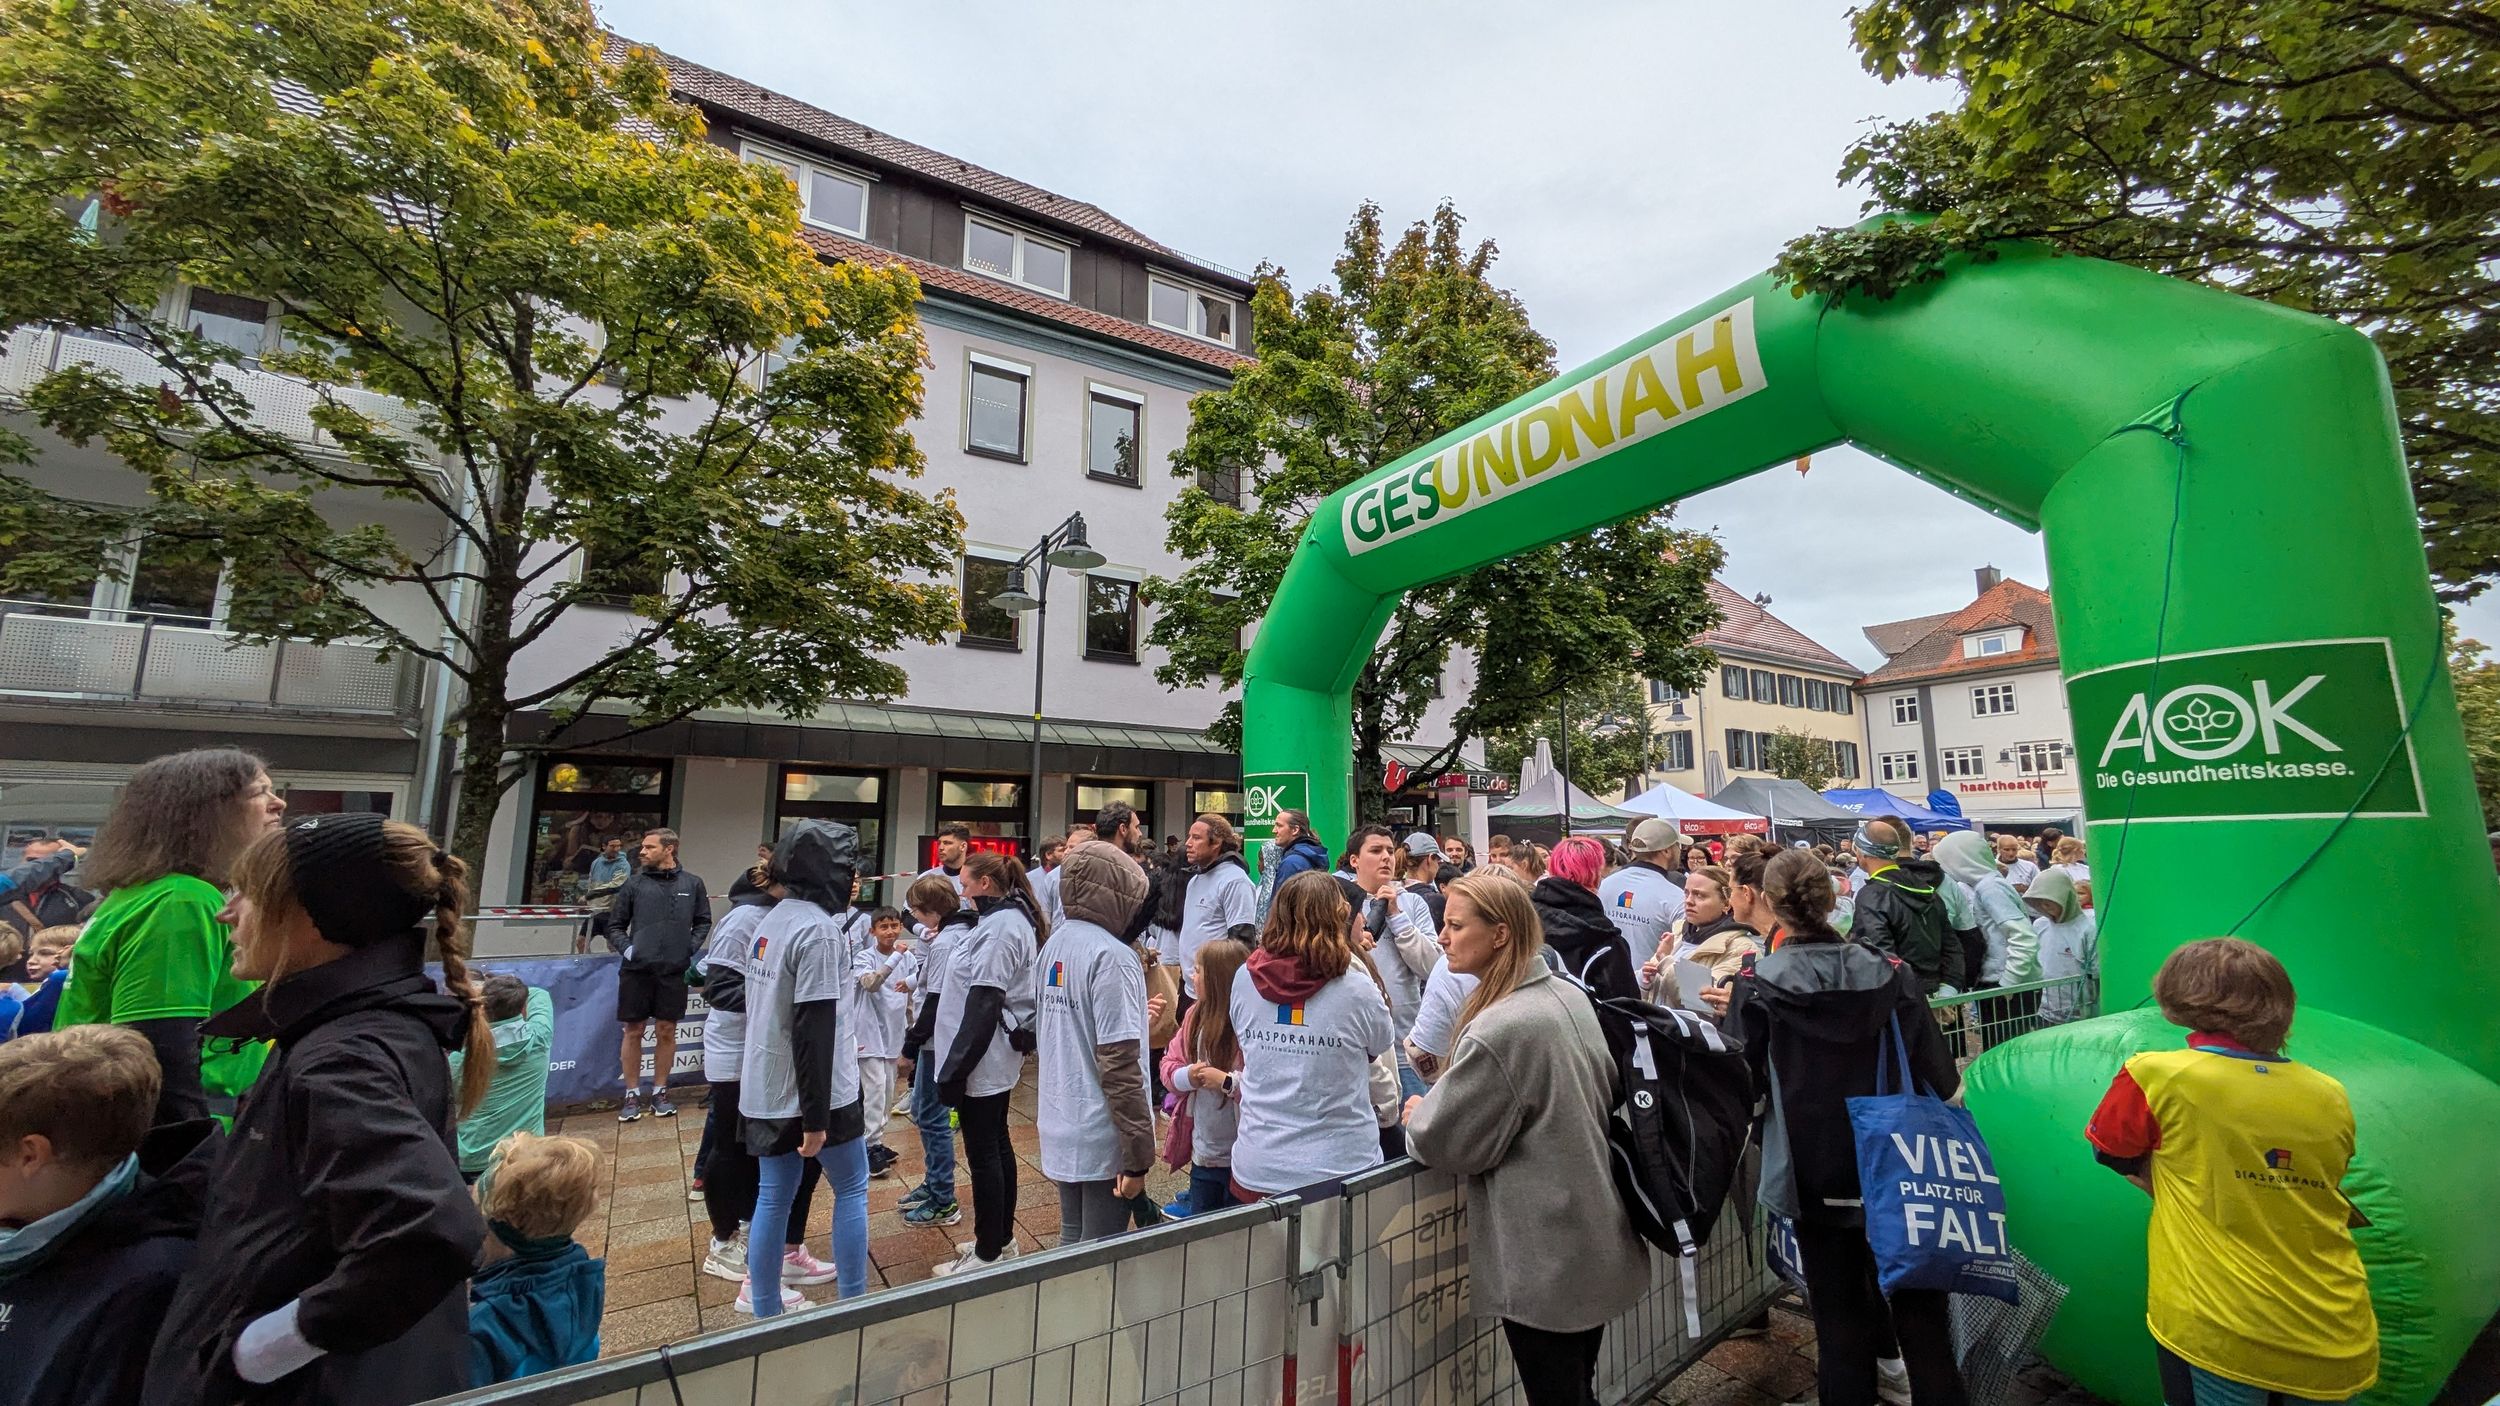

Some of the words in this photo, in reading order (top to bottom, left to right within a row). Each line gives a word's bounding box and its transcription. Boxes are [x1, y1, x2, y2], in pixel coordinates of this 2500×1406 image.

[1350, 313, 1743, 543] GESUNDNAH
[2098, 674, 2343, 767] AOK
[1960, 780, 2048, 792] haartheater
[2096, 772, 2118, 788] Die
[2121, 761, 2355, 786] Gesundheitskasse.
[1684, 821, 1699, 832] elco
[1744, 821, 1758, 831] elco
[1245, 1028, 1342, 1048] DIASPORAHAUS
[550, 1060, 576, 1071] DER
[1890, 1133, 2000, 1185] VIEL
[1900, 1181, 1953, 1200] PLATZ
[1954, 1186, 1984, 1205] FÜR
[1903, 1203, 2007, 1255] FALT
[1770, 1222, 1803, 1275] ALT
